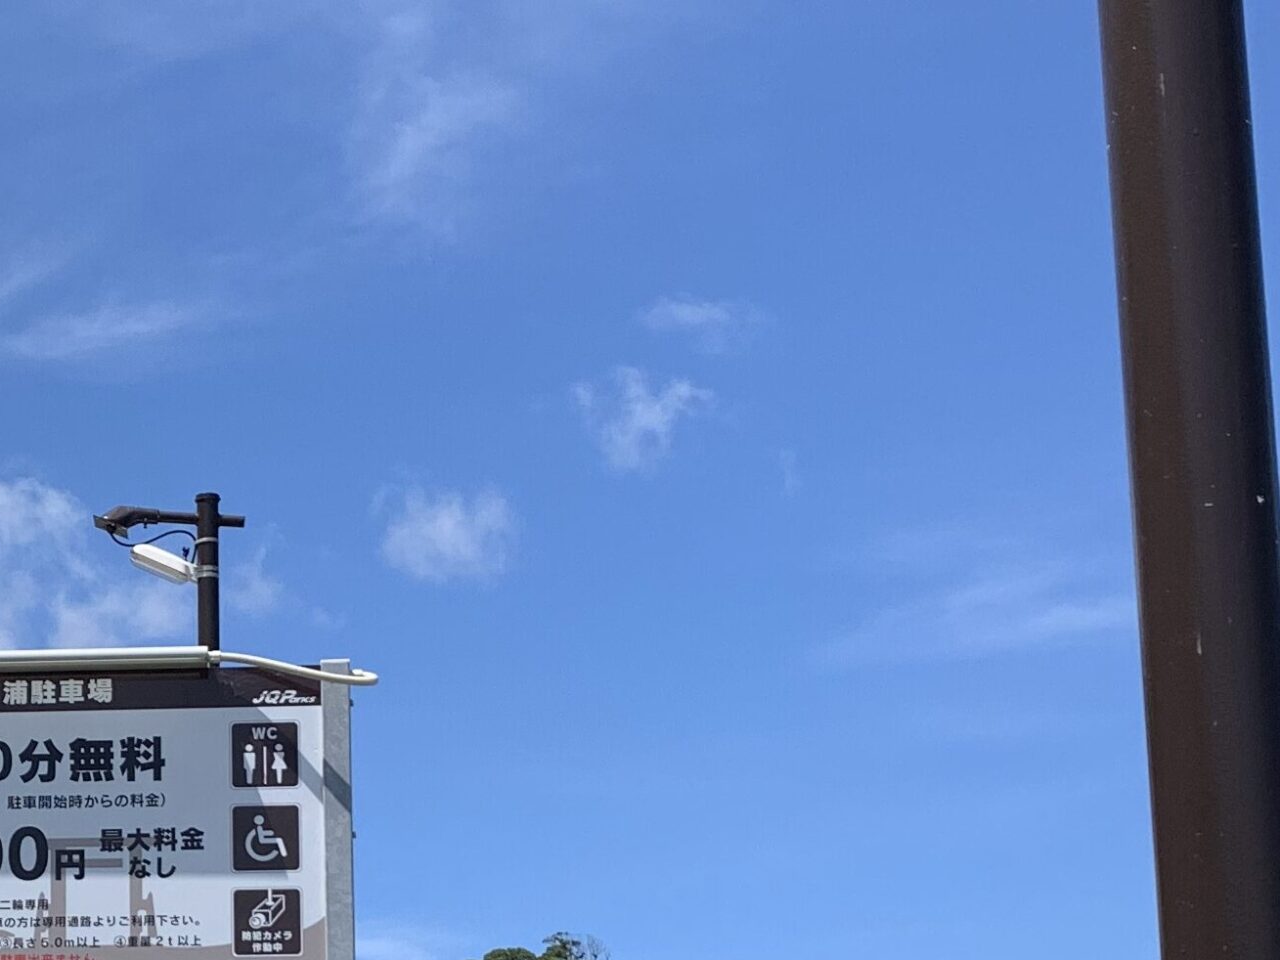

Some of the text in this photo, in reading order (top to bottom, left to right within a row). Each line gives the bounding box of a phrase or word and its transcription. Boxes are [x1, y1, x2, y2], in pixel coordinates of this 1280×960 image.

[252, 727, 278, 740] WC
[99, 827, 205, 853] 最大料金
[128, 856, 177, 879] なし
